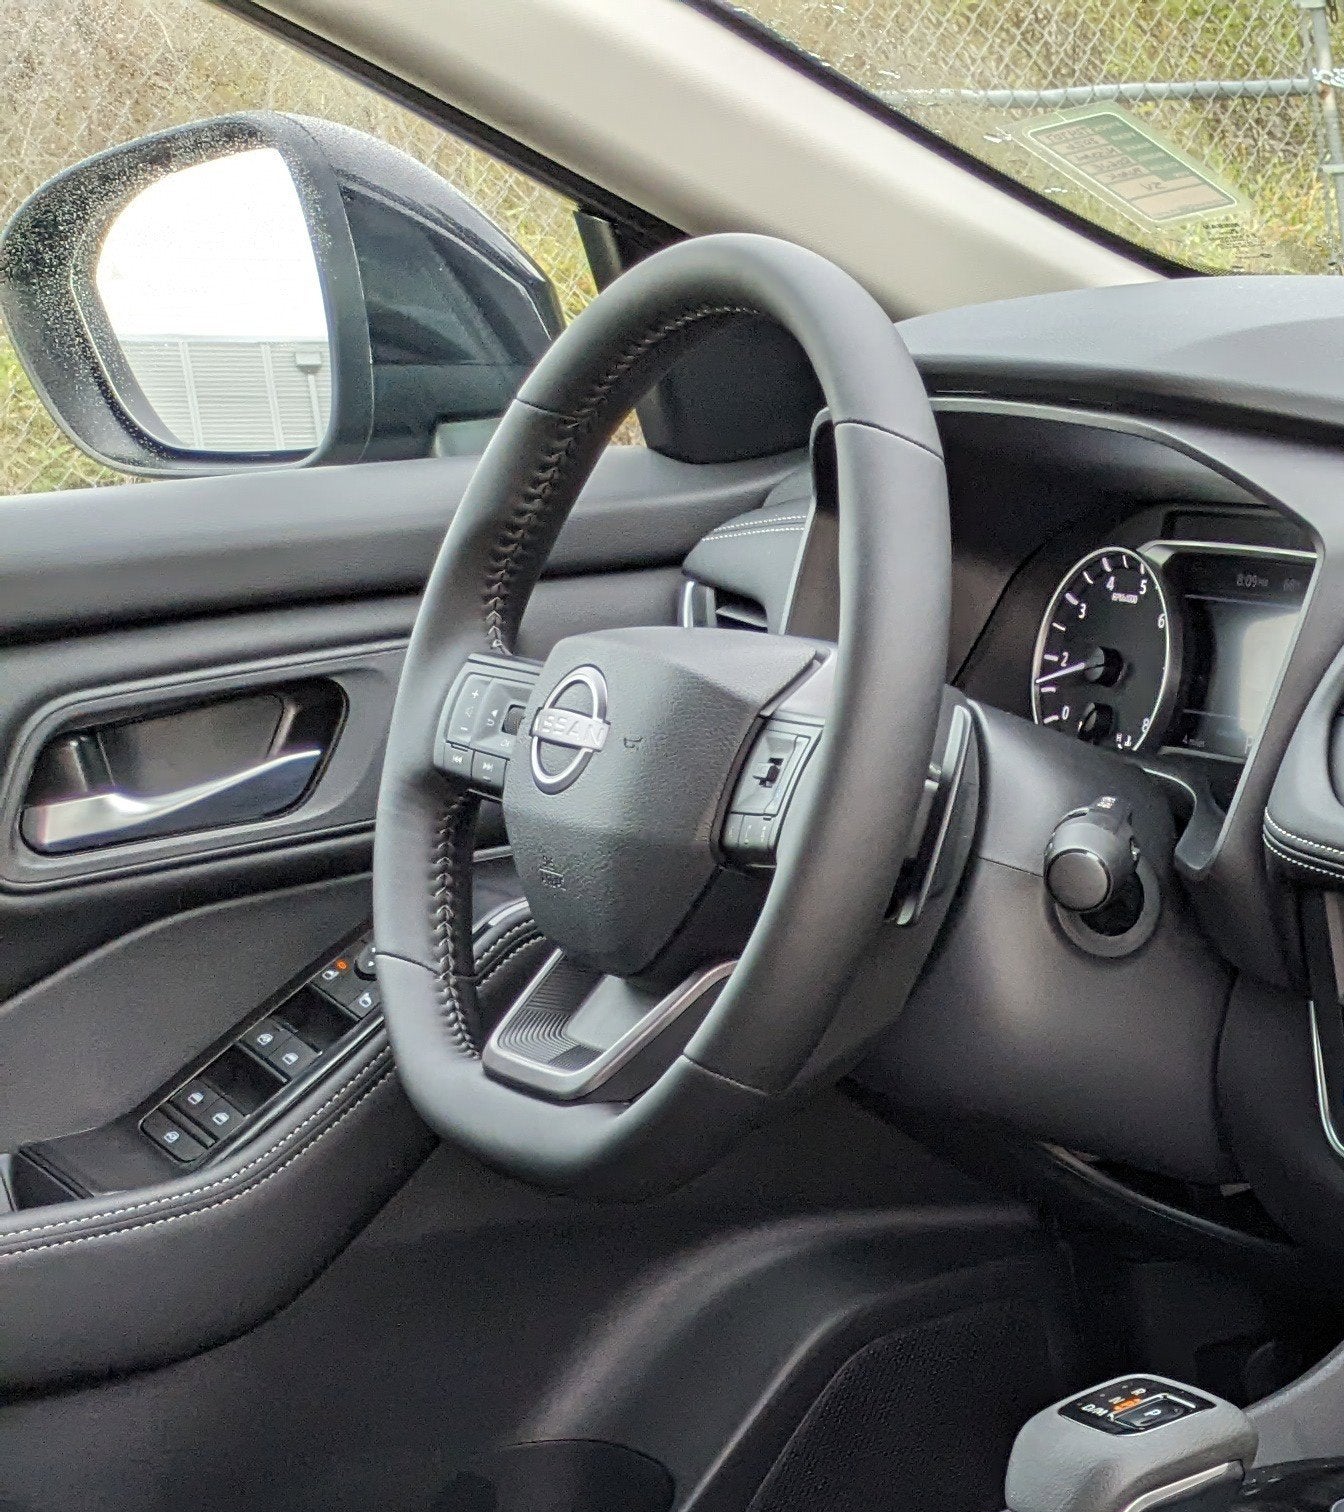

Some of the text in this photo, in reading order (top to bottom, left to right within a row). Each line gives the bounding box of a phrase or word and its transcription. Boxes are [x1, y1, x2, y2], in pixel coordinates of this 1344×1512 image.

[1139, 579, 1148, 595] 5
[1077, 602, 1087, 619] 3
[1060, 651, 1069, 667] 2
[1061, 705, 1070, 720] 0
